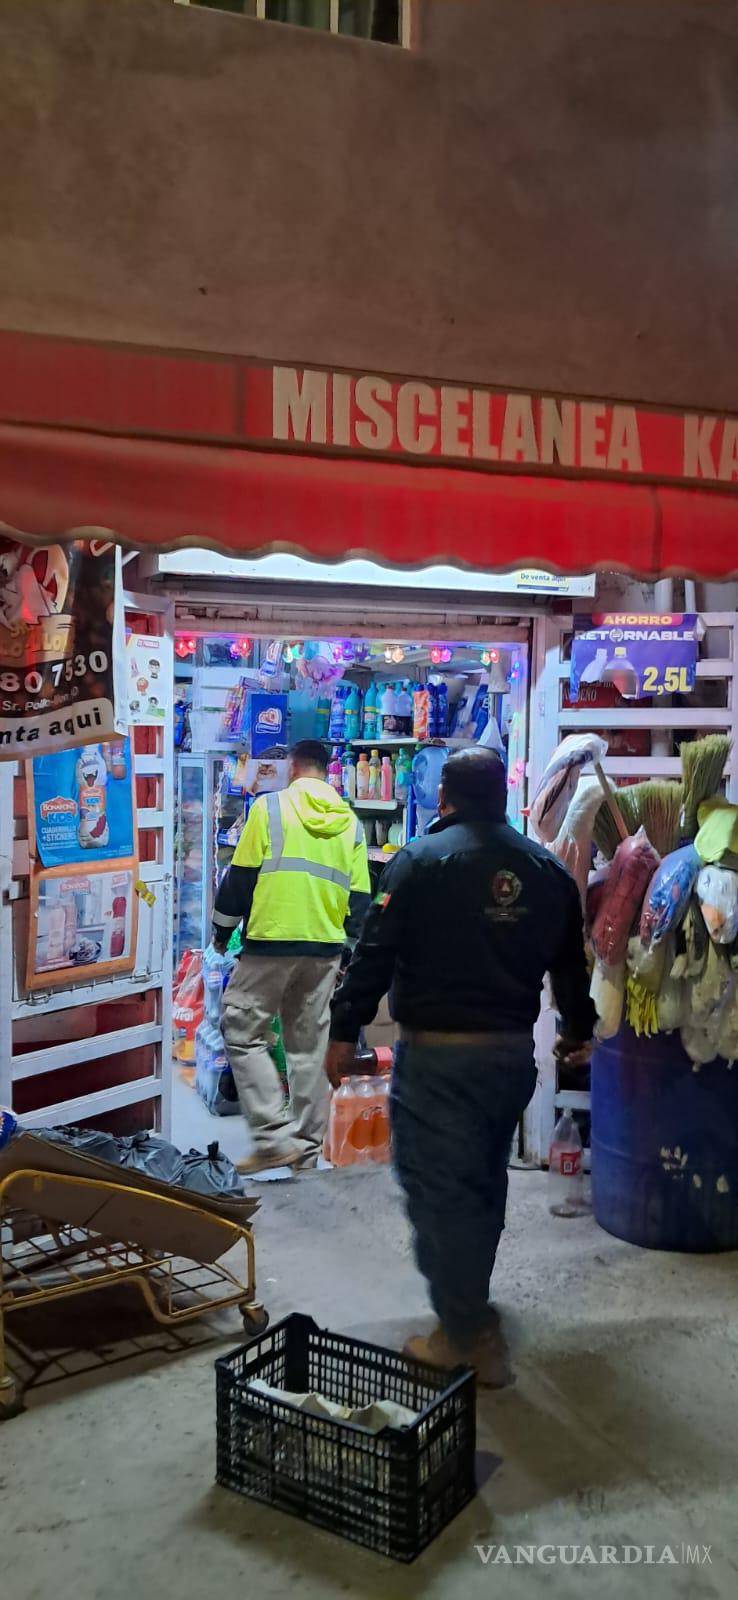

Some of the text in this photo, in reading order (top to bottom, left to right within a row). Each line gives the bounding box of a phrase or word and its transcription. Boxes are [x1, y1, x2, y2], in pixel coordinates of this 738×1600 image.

[272, 366, 643, 473] MISCELANEA
[520, 572, 529, 581] De
[530, 574, 550, 582] venta
[602, 614, 673, 626] AHORRO
[0, 650, 109, 694] 80 7530
[643, 666, 693, 696] 2,5L
[2, 700, 22, 712] Sr.
[48, 812, 74, 824] KIDS
